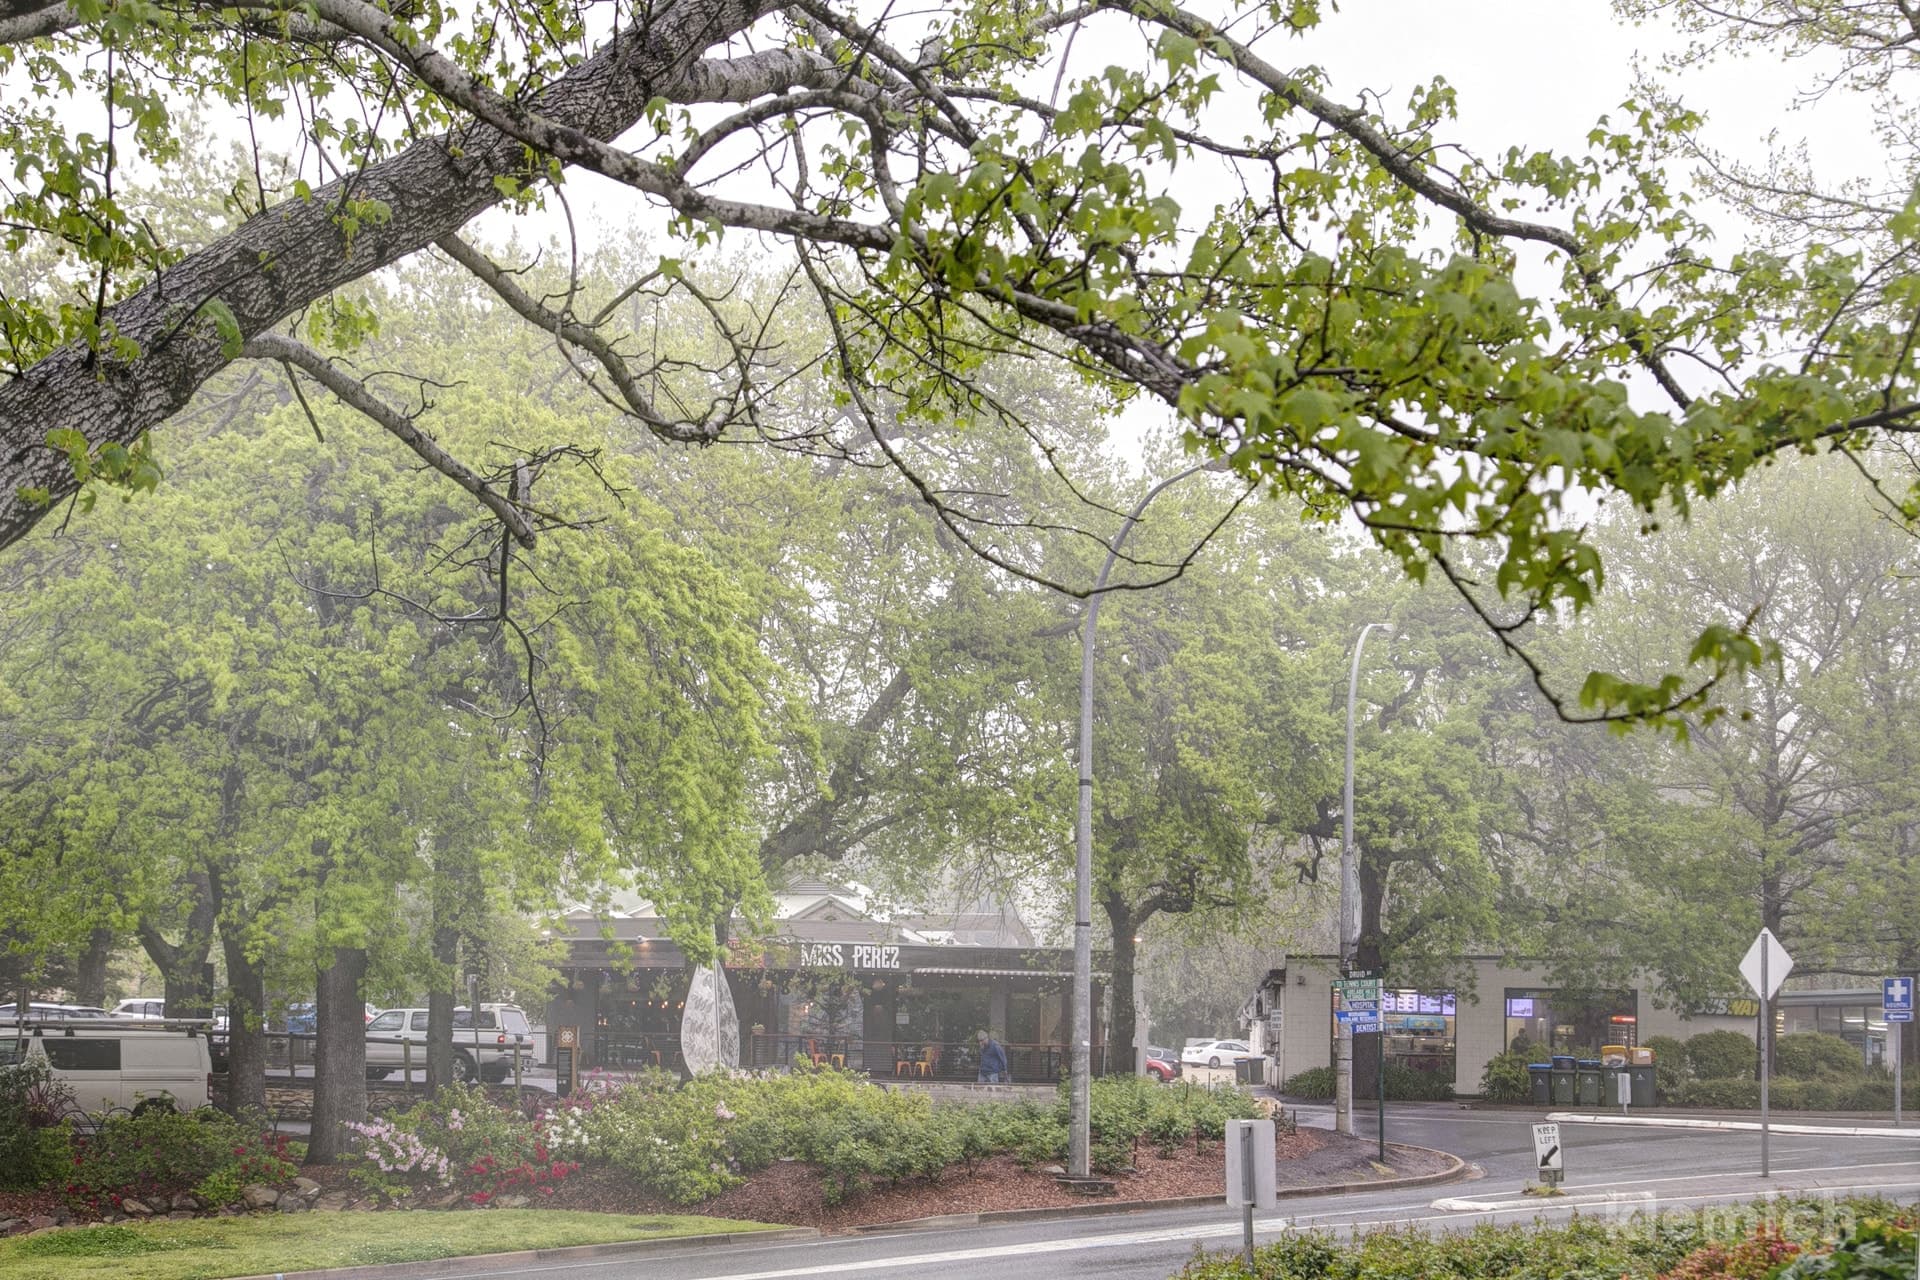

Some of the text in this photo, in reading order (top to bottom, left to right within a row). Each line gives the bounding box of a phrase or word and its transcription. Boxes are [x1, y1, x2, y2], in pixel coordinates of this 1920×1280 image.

[801, 944, 900, 969] MISS PEREZ
[1349, 970, 1366, 979] DRUID
[1351, 1001, 1376, 1009] HOSPITAL
[1356, 1023, 1377, 1033] DENTIST
[1537, 1126, 1556, 1135] KEEP
[1540, 1136, 1556, 1145] LEFT
